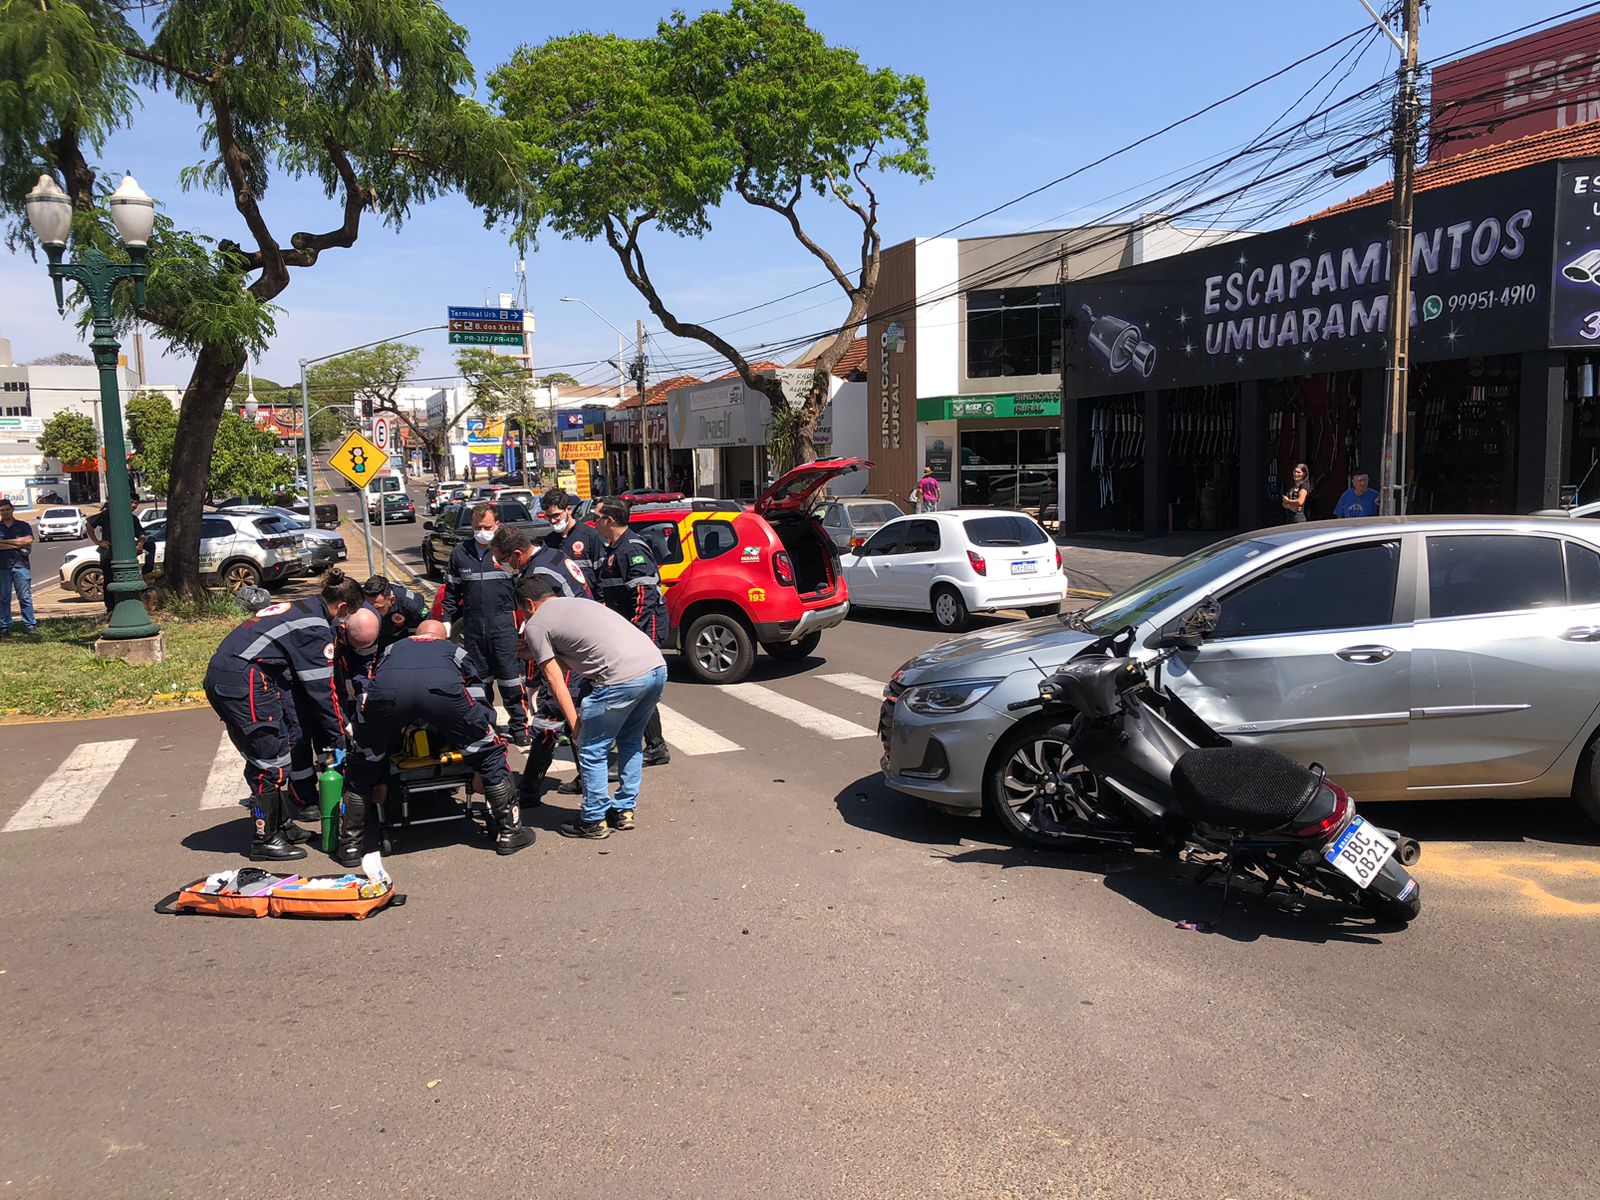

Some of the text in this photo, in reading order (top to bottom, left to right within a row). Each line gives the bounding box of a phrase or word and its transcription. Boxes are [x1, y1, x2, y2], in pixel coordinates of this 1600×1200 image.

[1204, 209, 1532, 314] ESCAPAMNTOS
[1448, 284, 1535, 312] 99951-4910
[450, 309, 482, 318] Terminal
[881, 332, 889, 449] SINDICATO
[1015, 392, 1061, 402] SINDICATO
[892, 374, 900, 449] RURAL
[1016, 404, 1044, 413] RURAL
[748, 593, 765, 602] 193
[1338, 831, 1355, 849] BRASIL
[1341, 831, 1371, 864] BBC
[1355, 839, 1390, 879] 6B21
